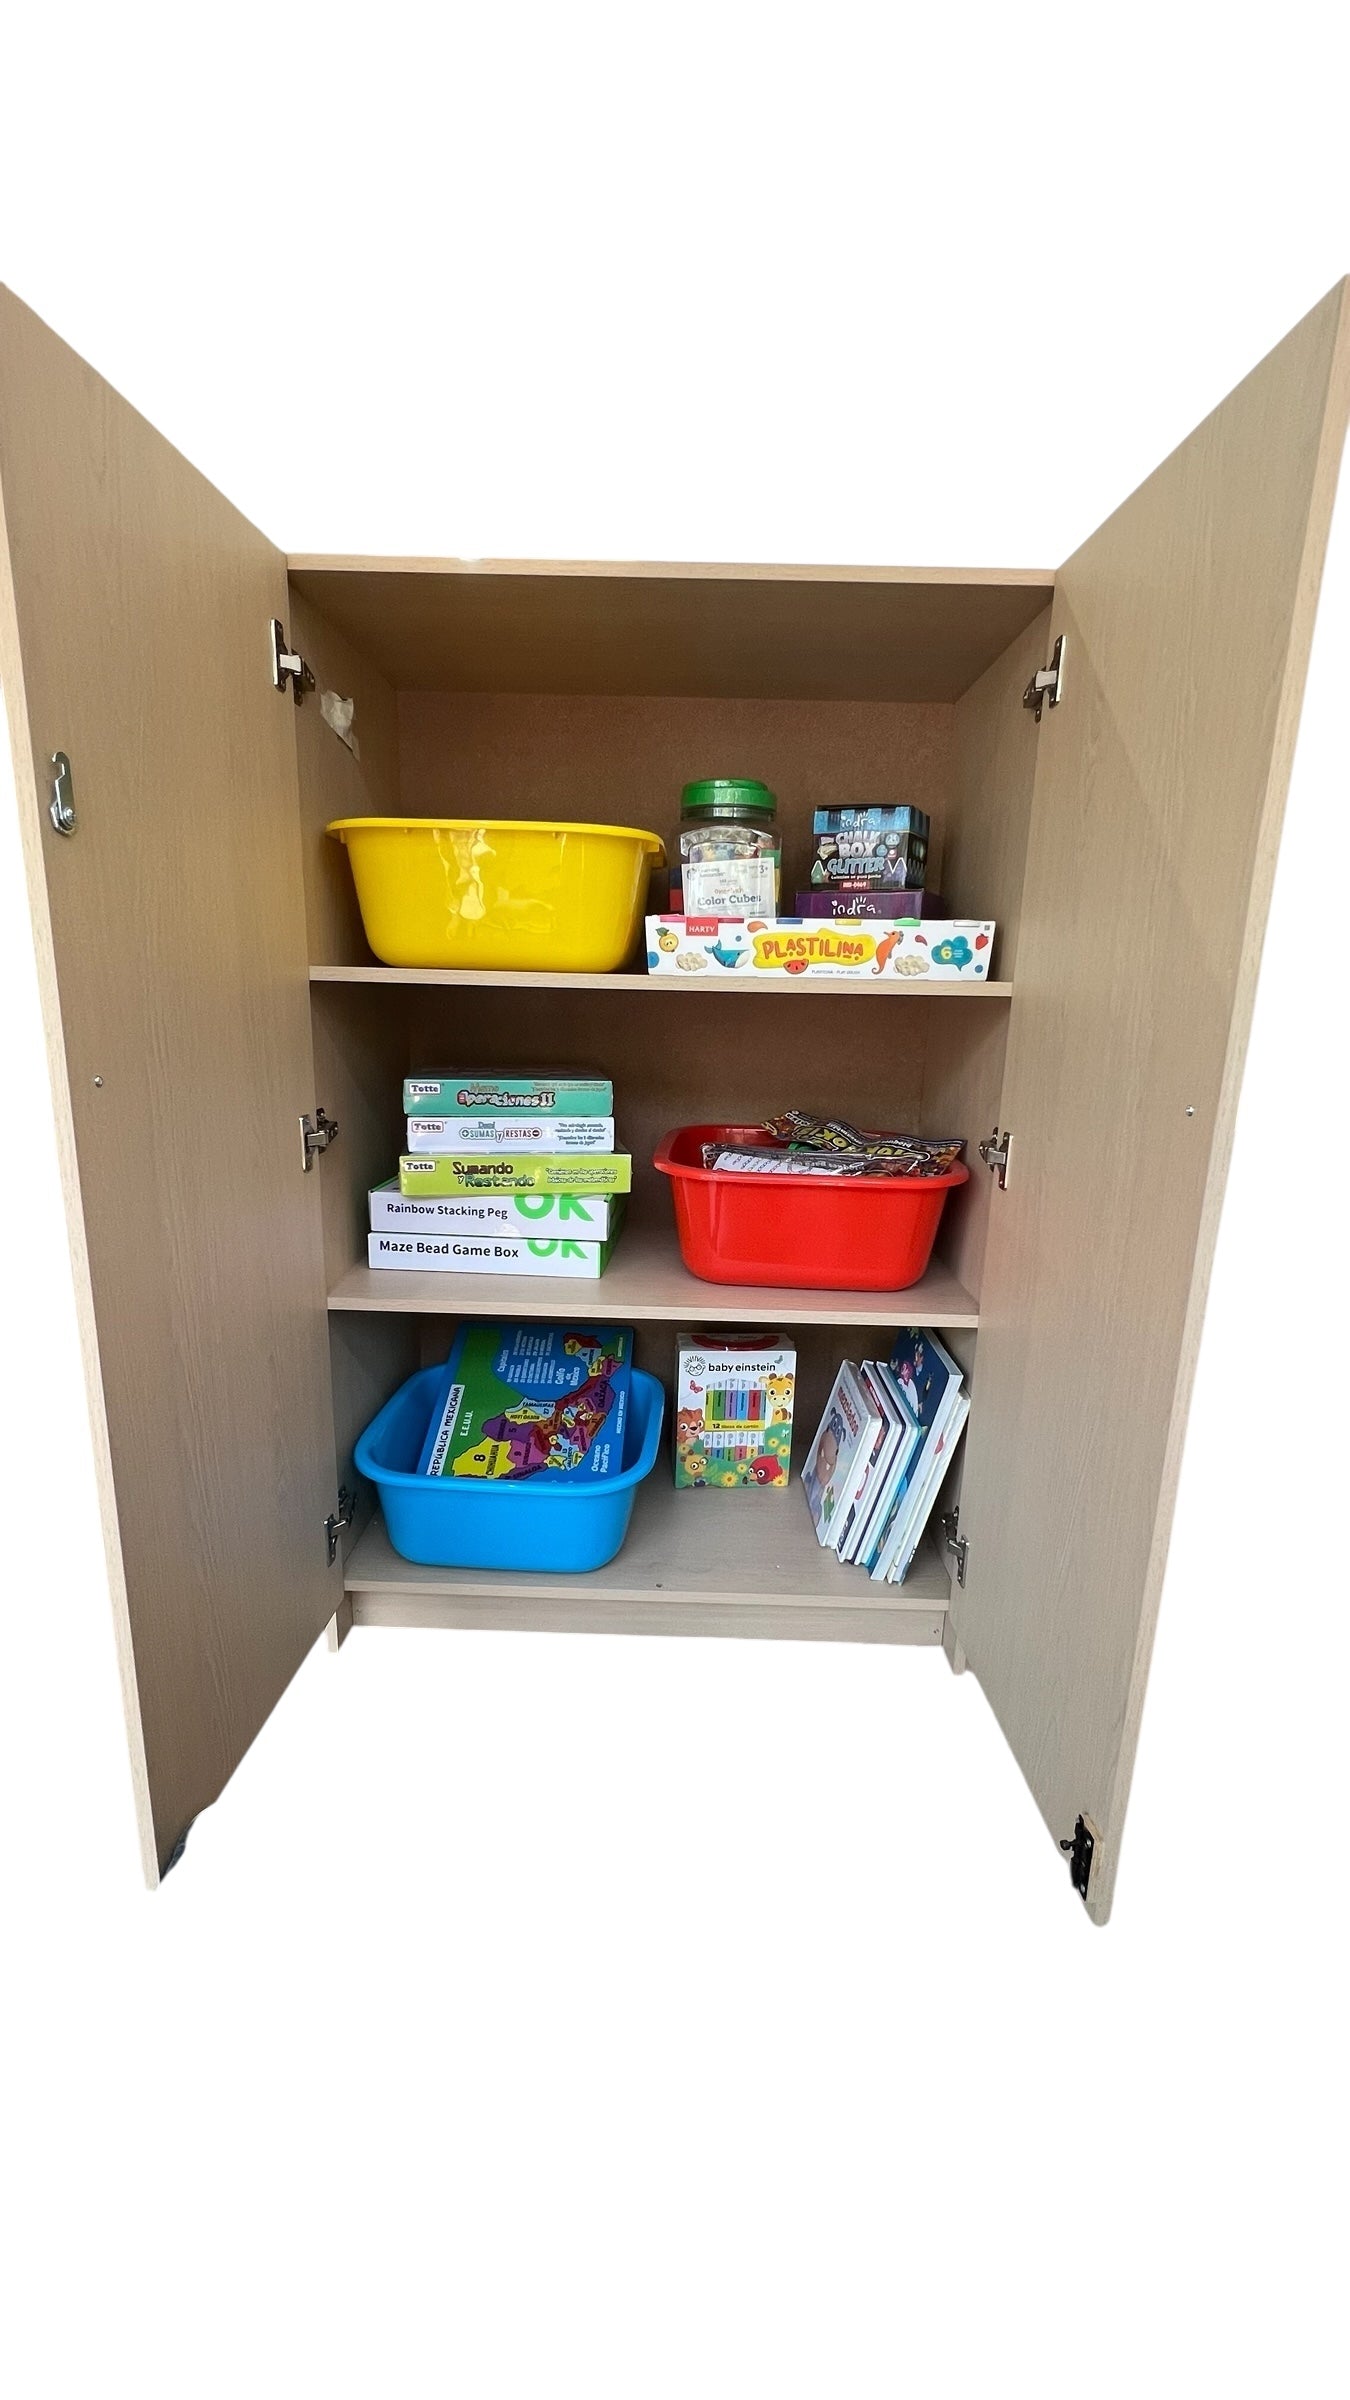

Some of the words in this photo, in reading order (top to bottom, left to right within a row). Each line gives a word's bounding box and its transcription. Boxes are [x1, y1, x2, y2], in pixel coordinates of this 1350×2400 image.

[841, 811, 876, 828] indra
[835, 830, 881, 844] CHALK
[838, 842, 877, 858] BOX
[827, 857, 885, 875] GLITTER
[697, 896, 726, 906] Color
[728, 894, 762, 904] Cubes
[831, 896, 877, 916] indra
[688, 925, 715, 934] HARTY
[762, 936, 865, 961] PLASTILINA
[940, 946, 953, 960] 6
[410, 1084, 439, 1093] Totte
[413, 1122, 442, 1131] Totte
[469, 1129, 495, 1138] SUMAS
[505, 1129, 532, 1138] RESTAS
[406, 1162, 434, 1171] Totte
[452, 1161, 514, 1175] Sumando
[457, 1175, 464, 1184] y
[465, 1173, 535, 1187] Restando
[386, 1203, 435, 1215] Rainbow
[437, 1205, 485, 1219] Stacking
[487, 1207, 508, 1219] Peg
[379, 1240, 413, 1253] Maze
[416, 1242, 449, 1254] Bead
[452, 1244, 491, 1257] Game
[494, 1246, 519, 1258] Box
[708, 1362, 736, 1373] baby
[735, 1362, 776, 1372] einstein
[444, 1386, 461, 1427] MEXICANA
[473, 1453, 487, 1462] 8
